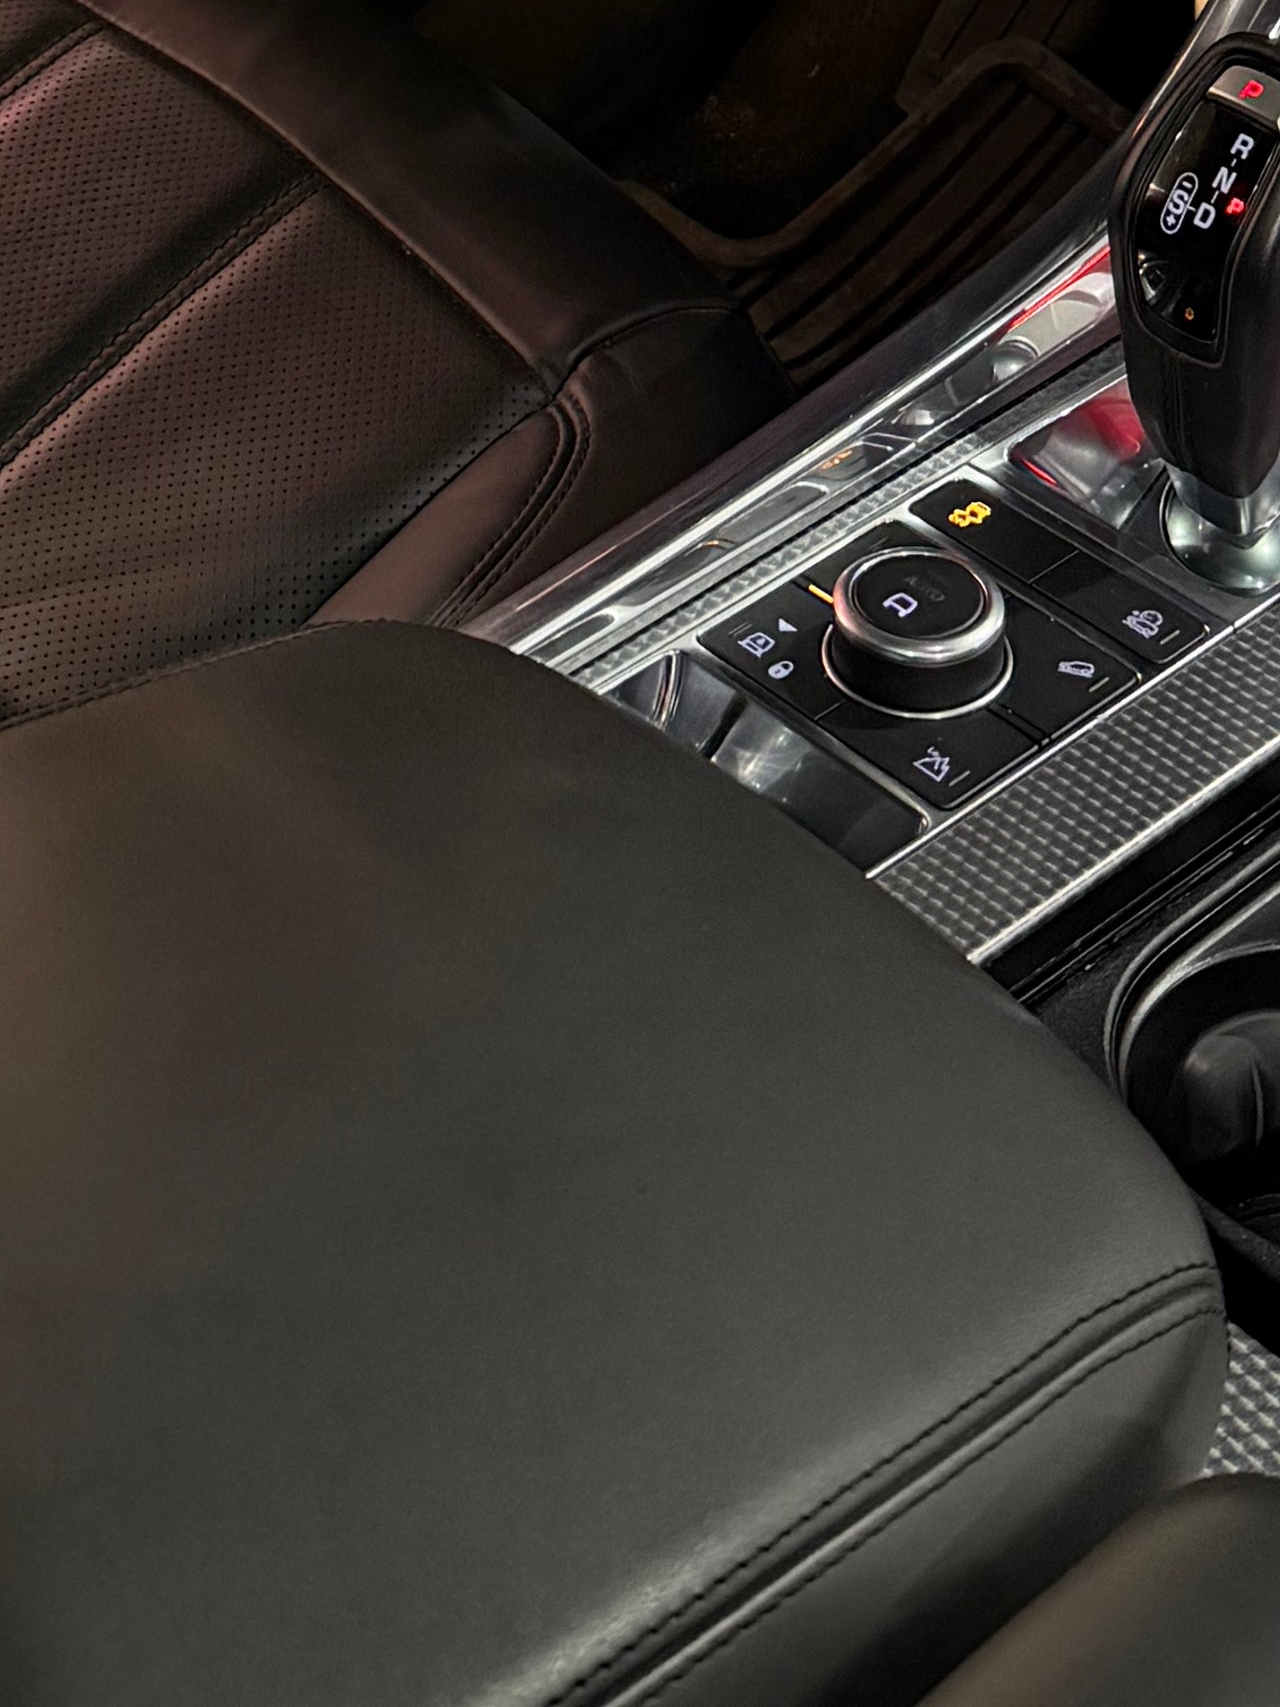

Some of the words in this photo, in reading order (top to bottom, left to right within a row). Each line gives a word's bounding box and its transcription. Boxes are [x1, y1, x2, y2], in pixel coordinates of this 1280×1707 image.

[1238, 79, 1265, 101] P
[1229, 132, 1255, 160] R
[1211, 165, 1238, 195] N
[1168, 189, 1189, 217] S
[1193, 201, 1217, 230] D
